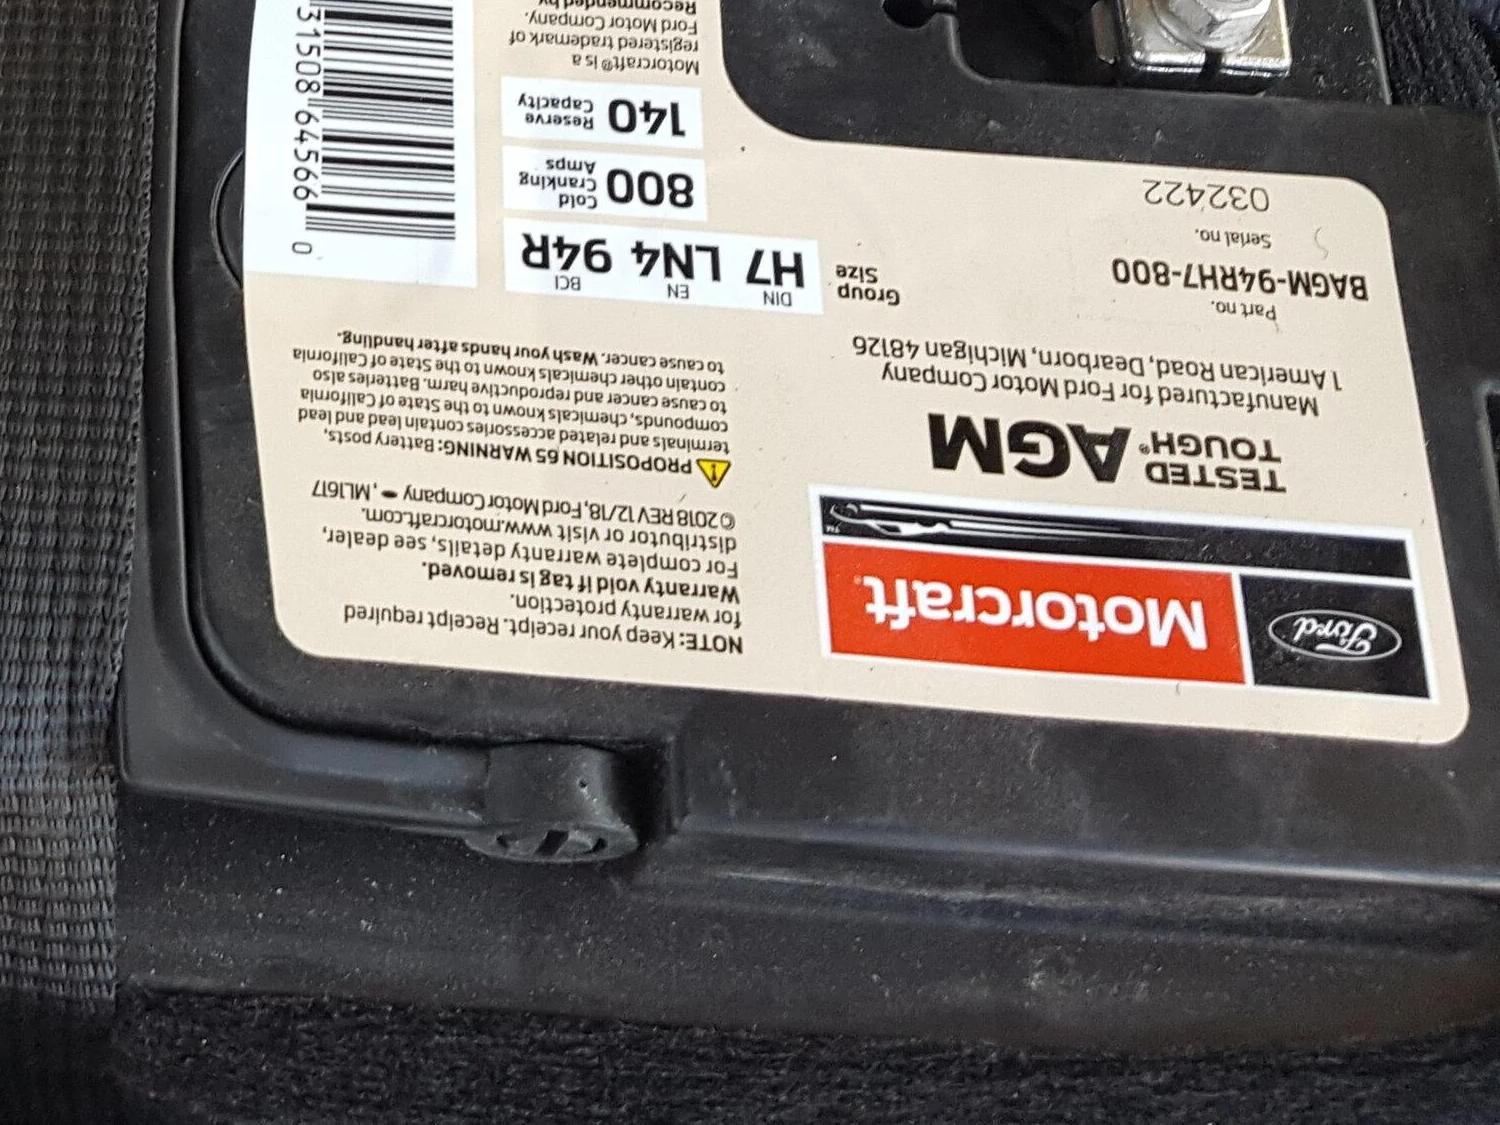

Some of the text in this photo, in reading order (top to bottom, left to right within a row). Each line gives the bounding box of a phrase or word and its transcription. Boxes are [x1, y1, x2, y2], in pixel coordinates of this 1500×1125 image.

[525, 10, 698, 36] Ford Motor Company.
[294, 5, 321, 95] 31508
[518, 93, 594, 114] Capacity
[608, 99, 686, 138] 140
[525, 113, 594, 131] Reserve
[292, 109, 320, 202] 64566
[546, 157, 596, 176] Amps
[519, 171, 597, 193] Cranking
[607, 169, 694, 209] 800
[1142, 179, 1270, 213] 032422
[559, 194, 598, 210] Cold
[522, 233, 613, 274] 94R
[1195, 229, 1272, 250] Serial no.
[631, 241, 721, 283] LN4
[746, 249, 805, 289] H7
[836, 265, 879, 284] Size
[555, 275, 582, 292] BCI
[667, 283, 690, 300] EN
[837, 283, 901, 307] Group
[1112, 258, 1369, 302] BAGM-94RH7-800
[763, 290, 793, 308] DIN
[1211, 300, 1278, 322] Part no.
[852, 336, 1343, 392] 1 American Road, Dearborn, Michigan 48126
[881, 362, 1320, 418] Manufactured for Ford Motor Company
[324, 428, 693, 475] PROPOSITION 65 WARNING: Battery posts,
[928, 413, 1132, 484] AGM
[312, 480, 371, 502] ML1617
[1145, 461, 1287, 494] TESTED
[403, 484, 485, 512] Company
[487, 495, 540, 517] Motor
[542, 500, 582, 520] Ford
[584, 500, 636, 524] 12/18,
[361, 508, 738, 555] distributor or visit www.motorcraft.com.
[637, 507, 675, 527] REV
[323, 526, 739, 580] For complete warranty details, see dealer,
[422, 562, 741, 605] Warranty void if tag is removed.
[510, 594, 742, 630] for warranty protection.
[861, 576, 1208, 651] Motorcraft
[344, 605, 744, 655] NOTE: Keep your receipt. Receipt required
[1291, 615, 1379, 657] Ford
